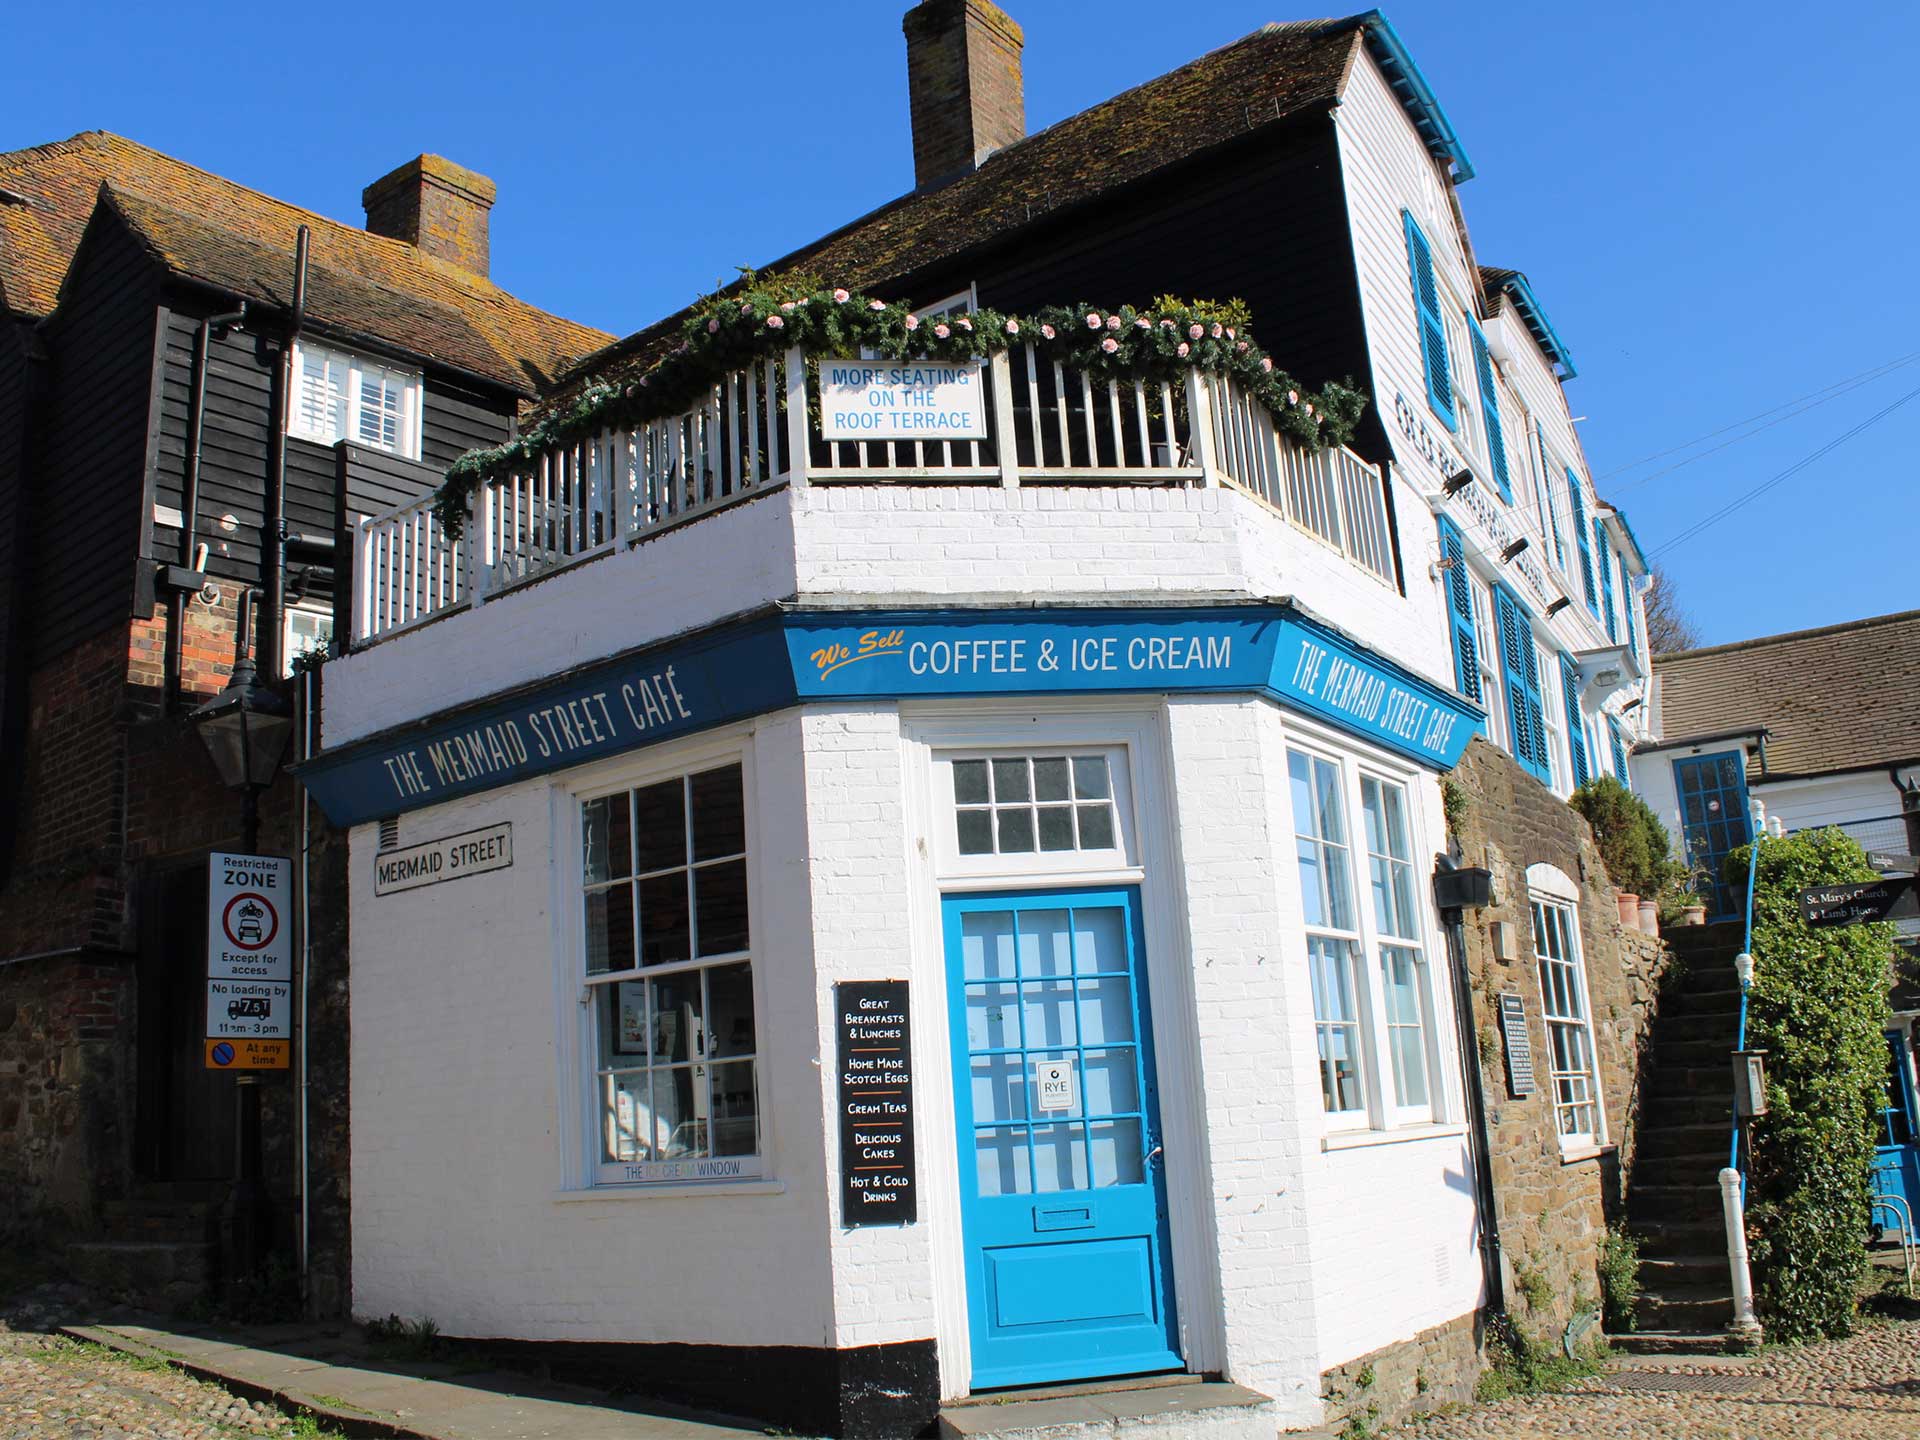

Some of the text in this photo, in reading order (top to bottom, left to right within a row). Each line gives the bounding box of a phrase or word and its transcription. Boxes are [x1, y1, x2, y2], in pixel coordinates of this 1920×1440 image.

[833, 368, 969, 385] MORE SEATING
[869, 390, 936, 407] ON THE
[835, 412, 972, 429] ROOF TERRACE
[809, 629, 1231, 675] We Sell COFFEE & ICE CREAM
[1292, 640, 1458, 755] THE MERMAID STREET CAFÉ
[384, 664, 692, 798] THE MERMAID STREET CAFÉ
[223, 857, 278, 871] Restricted
[378, 835, 506, 886] MERMAID STREET
[223, 871, 277, 889] ZONE
[1820, 893, 1852, 904] Mary's
[1854, 888, 1888, 900] Church
[1809, 906, 1879, 920] & Lamb House
[222, 952, 278, 967] Except for
[231, 965, 268, 975] access
[212, 983, 287, 997] No loading by
[859, 998, 890, 1009] GREAT
[845, 1013, 905, 1024] BREAKFASTS
[849, 1028, 901, 1039] & LUNCHES
[246, 1043, 281, 1055] At any
[252, 1056, 276, 1065] time
[848, 1057, 904, 1069] HOME MADE
[844, 1072, 909, 1085] SCOTCH EGGS
[1044, 1081, 1068, 1093] RYE
[848, 1102, 907, 1114] CREAM TEAS
[855, 1133, 902, 1145] DELICIOUS
[863, 1147, 895, 1159] CAKES
[625, 1166, 643, 1179] THE
[697, 1160, 741, 1176] WINDOW
[850, 1175, 909, 1188] HOT & COLD
[863, 1191, 897, 1203] DRINKS
